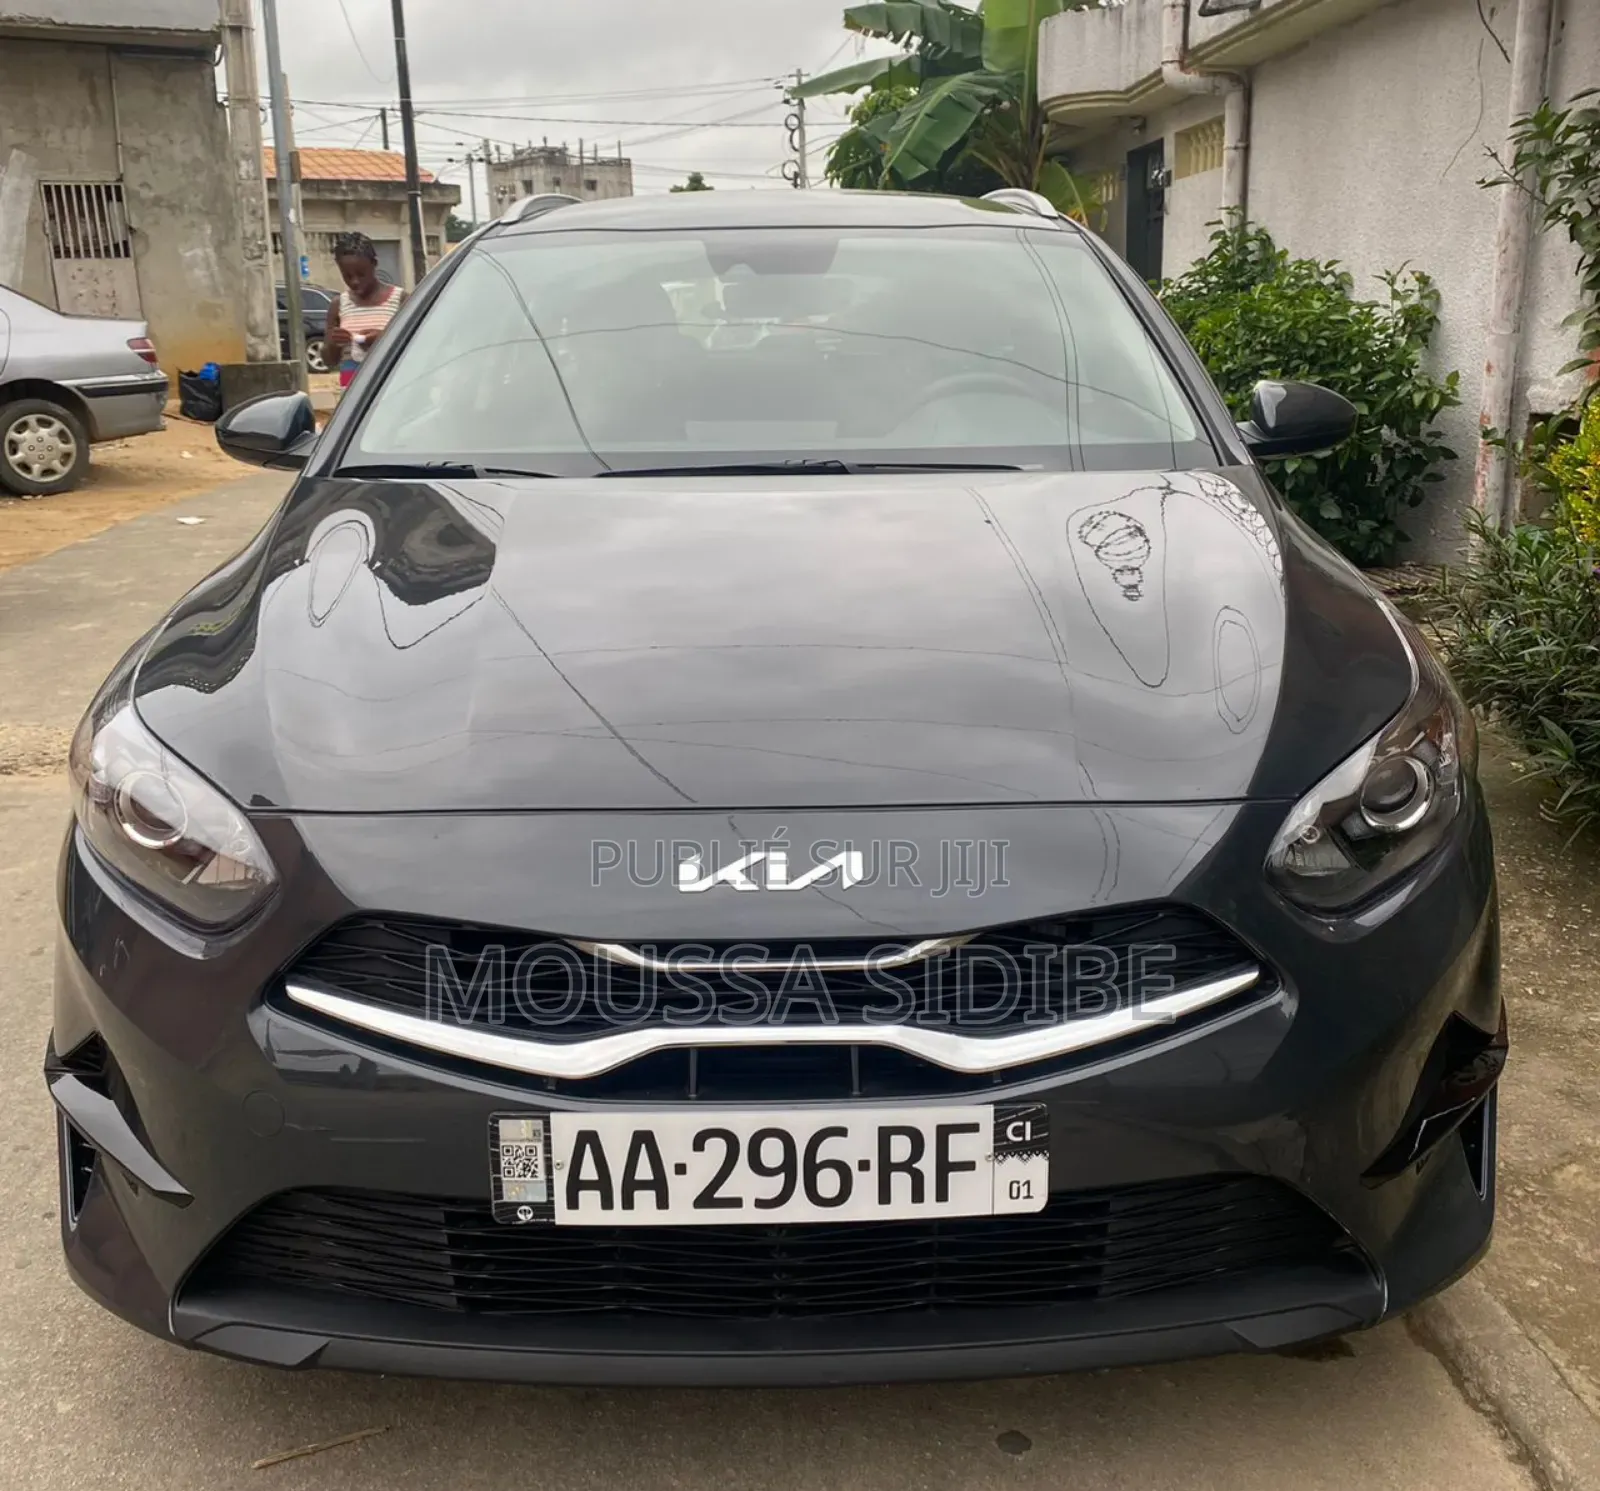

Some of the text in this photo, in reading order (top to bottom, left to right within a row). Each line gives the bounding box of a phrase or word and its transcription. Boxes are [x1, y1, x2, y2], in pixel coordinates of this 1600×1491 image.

[679, 851, 864, 893] KIA
[1006, 1121, 1031, 1142] CI
[1008, 1179, 1035, 1200] 01
